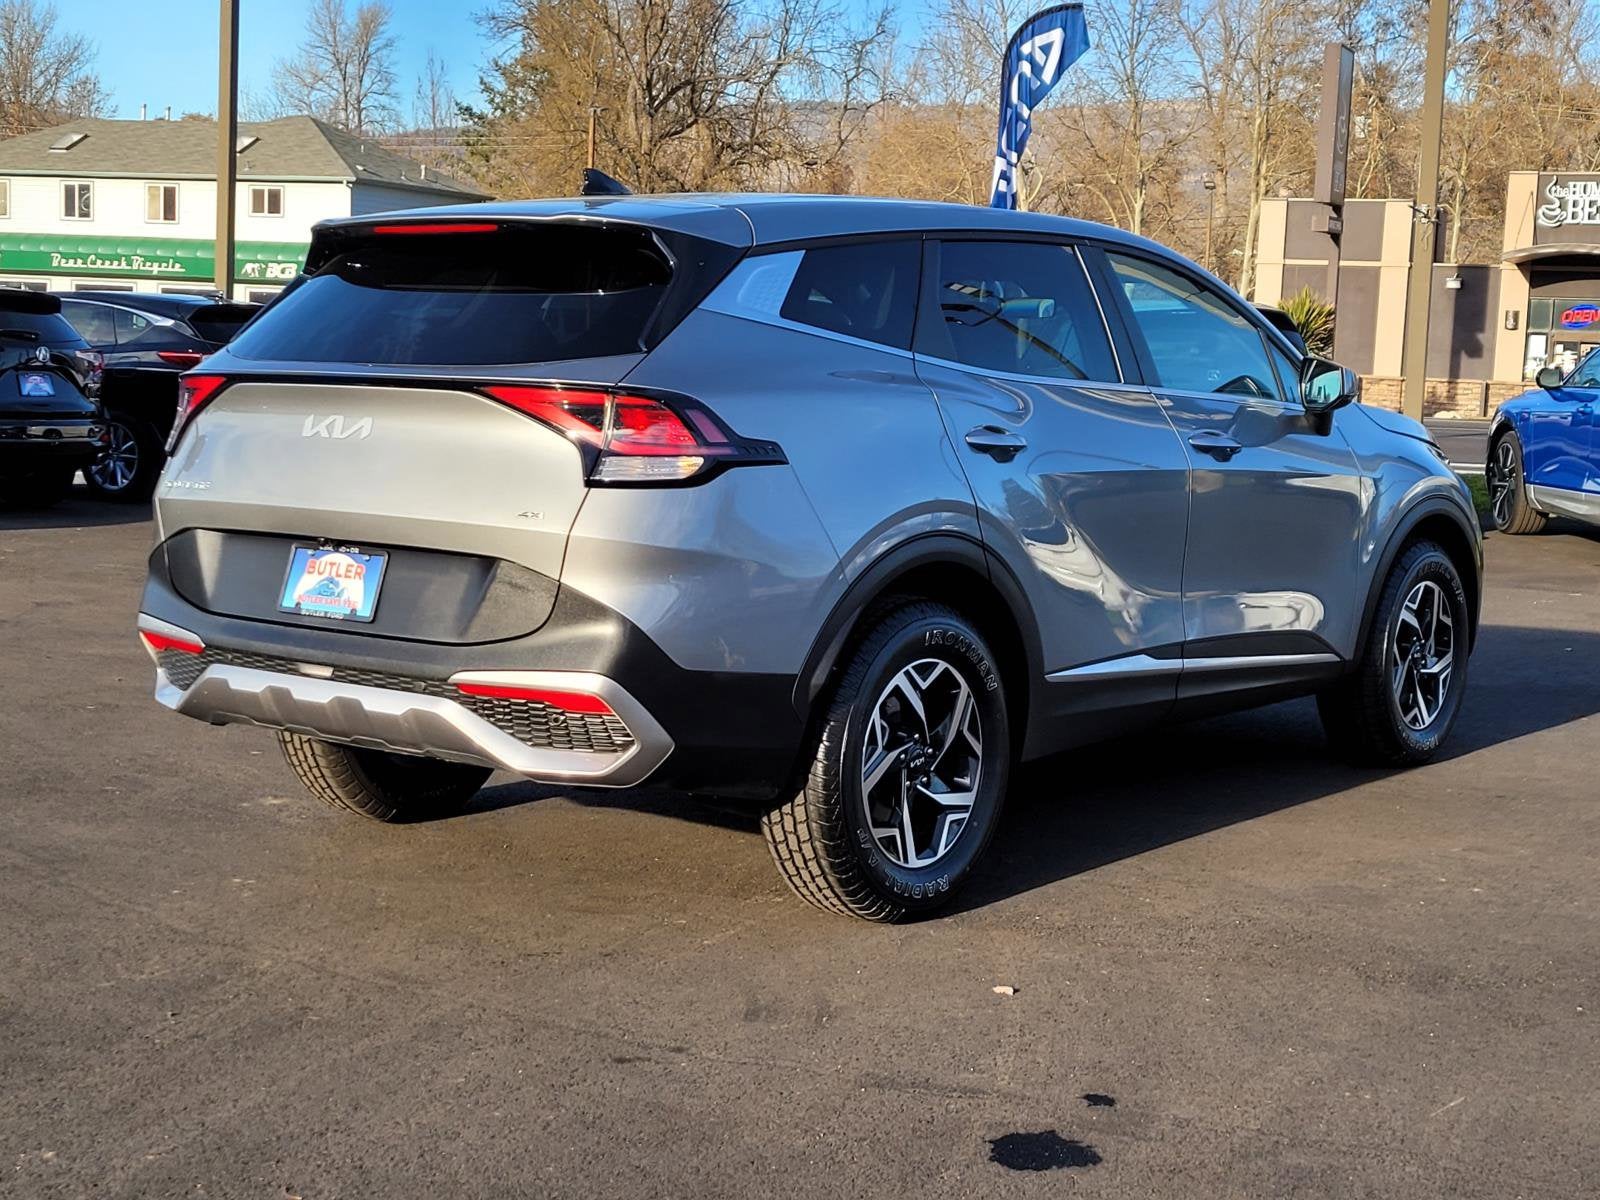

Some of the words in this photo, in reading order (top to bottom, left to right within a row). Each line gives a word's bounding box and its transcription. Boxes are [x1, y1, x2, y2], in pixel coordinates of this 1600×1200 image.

[51, 253, 87, 268] Bear
[87, 254, 131, 270] Creek
[131, 256, 186, 275] Bicycle
[1560, 309, 1600, 324] OPEN
[302, 414, 373, 439] KIA
[306, 559, 365, 580] BUTLER
[925, 629, 998, 691] IRONMAN
[885, 869, 949, 899] RADIAL
